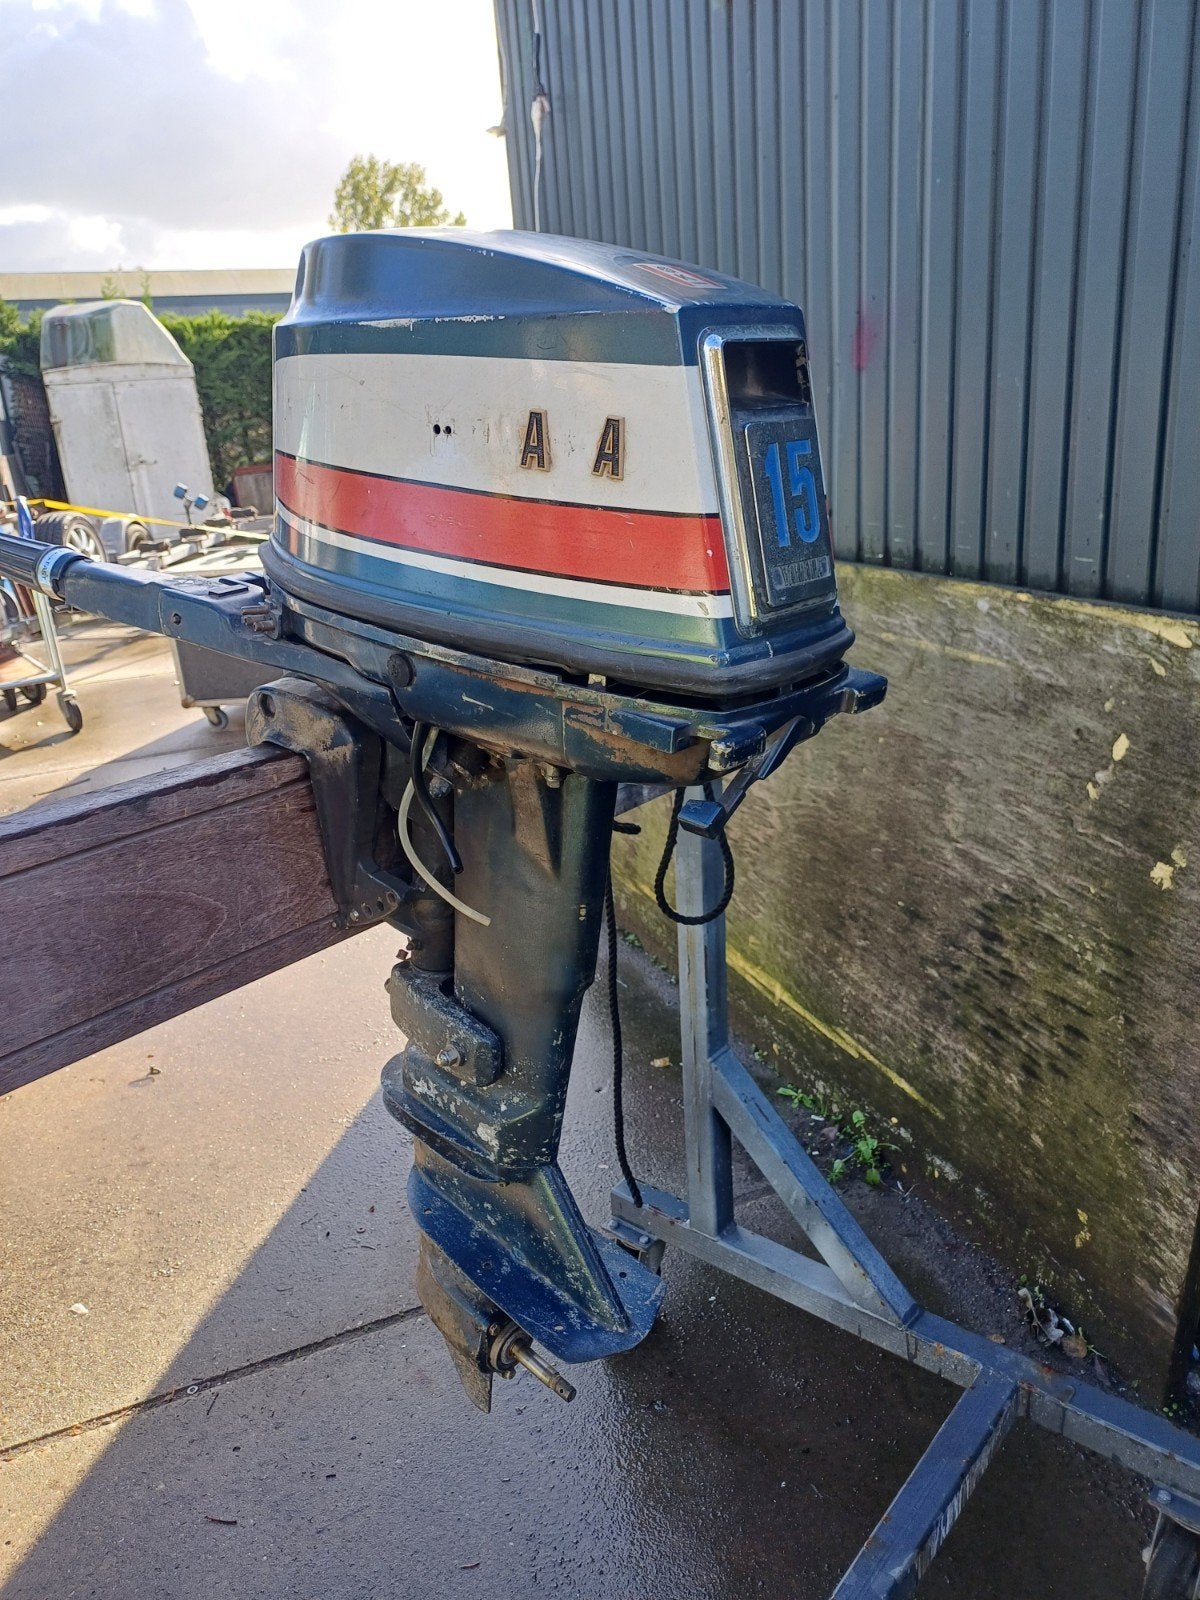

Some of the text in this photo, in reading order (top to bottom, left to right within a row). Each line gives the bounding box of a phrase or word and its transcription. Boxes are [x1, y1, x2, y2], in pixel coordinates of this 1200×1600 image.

[519, 408, 625, 480] A A
[764, 438, 821, 548] 15
